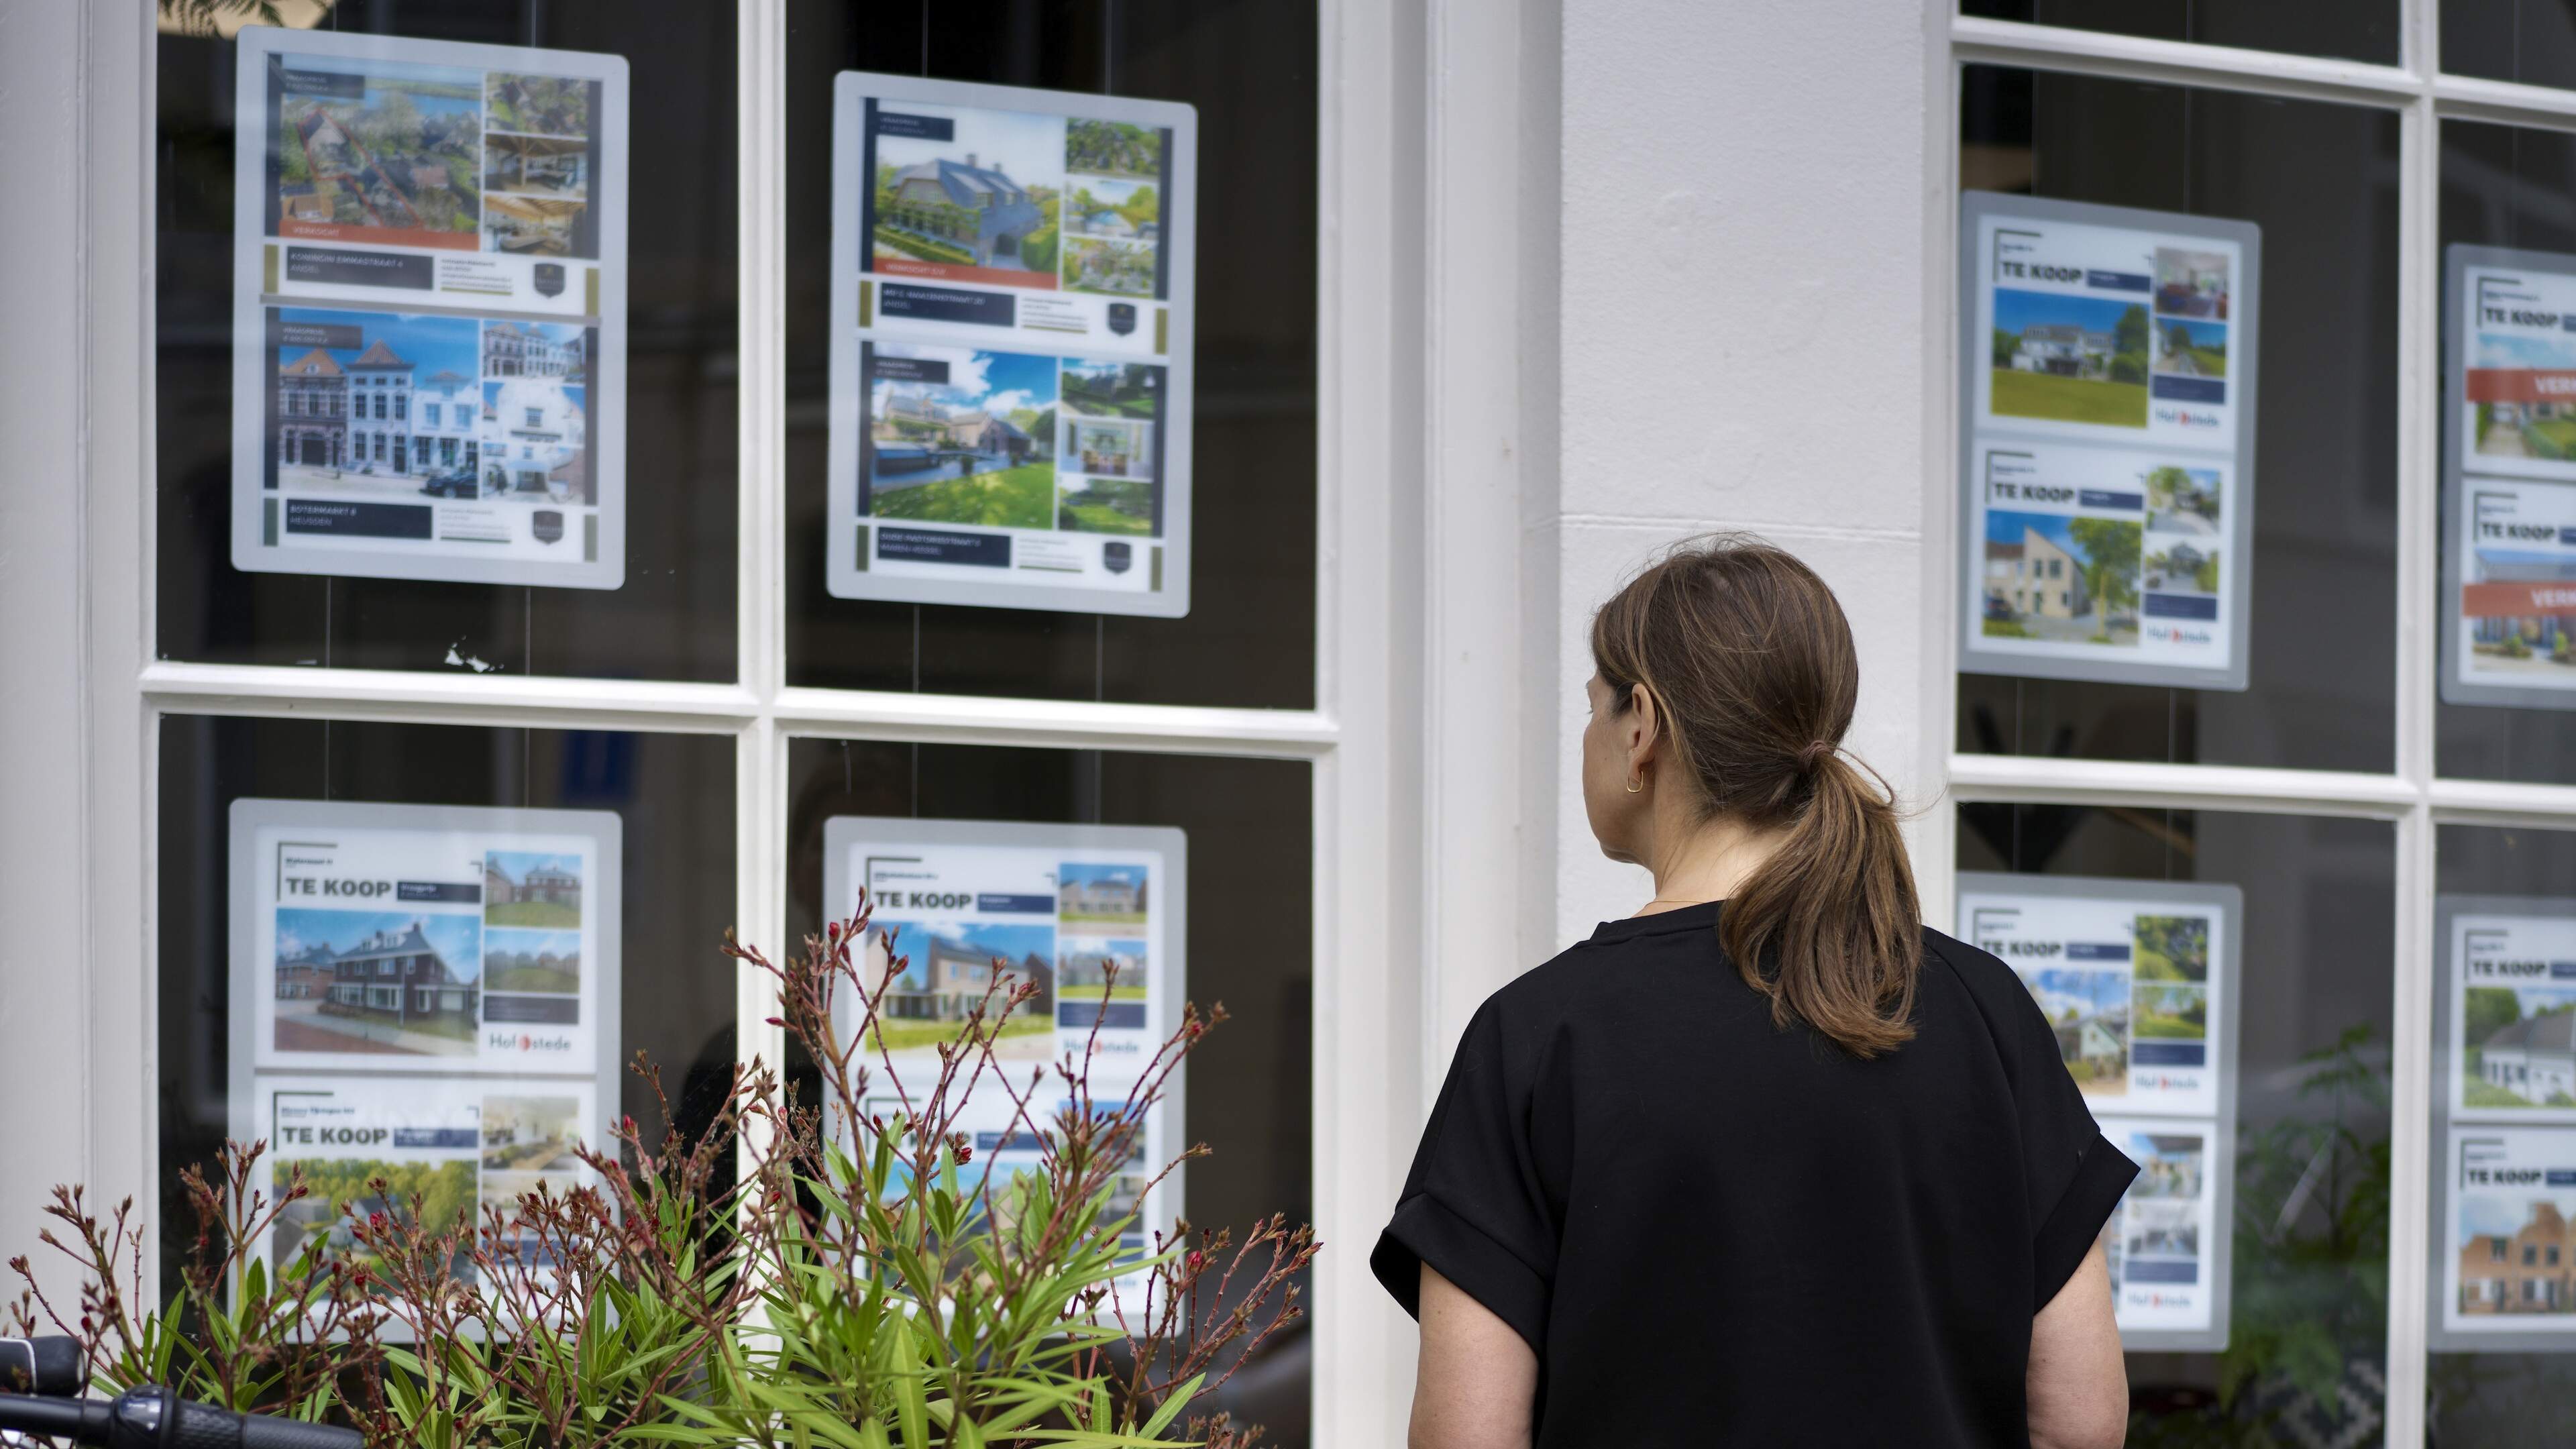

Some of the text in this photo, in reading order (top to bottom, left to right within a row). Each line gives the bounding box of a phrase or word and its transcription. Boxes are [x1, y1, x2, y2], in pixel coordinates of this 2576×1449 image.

[2002, 262, 2023, 277] TE
[2030, 264, 2082, 283] KOOP
[2485, 308, 2505, 323] TE
[2511, 310, 2558, 327] KOOP
[1996, 482, 2016, 499] TE
[2023, 485, 2074, 502] KOOP
[2482, 522, 2502, 537] TE
[2508, 524, 2555, 541] KOOP
[285, 877, 392, 898] TE KOOP
[874, 891, 902, 908] TE
[910, 892, 972, 909] KOOP
[1982, 940, 2003, 955] TE
[2010, 941, 2061, 958] KOOP
[2473, 960, 2493, 975] TE
[2498, 960, 2546, 977] KOOP
[282, 1126, 388, 1145] TE KOOP
[2469, 1169, 2489, 1185] TE
[2493, 1169, 2542, 1185] KOOP
